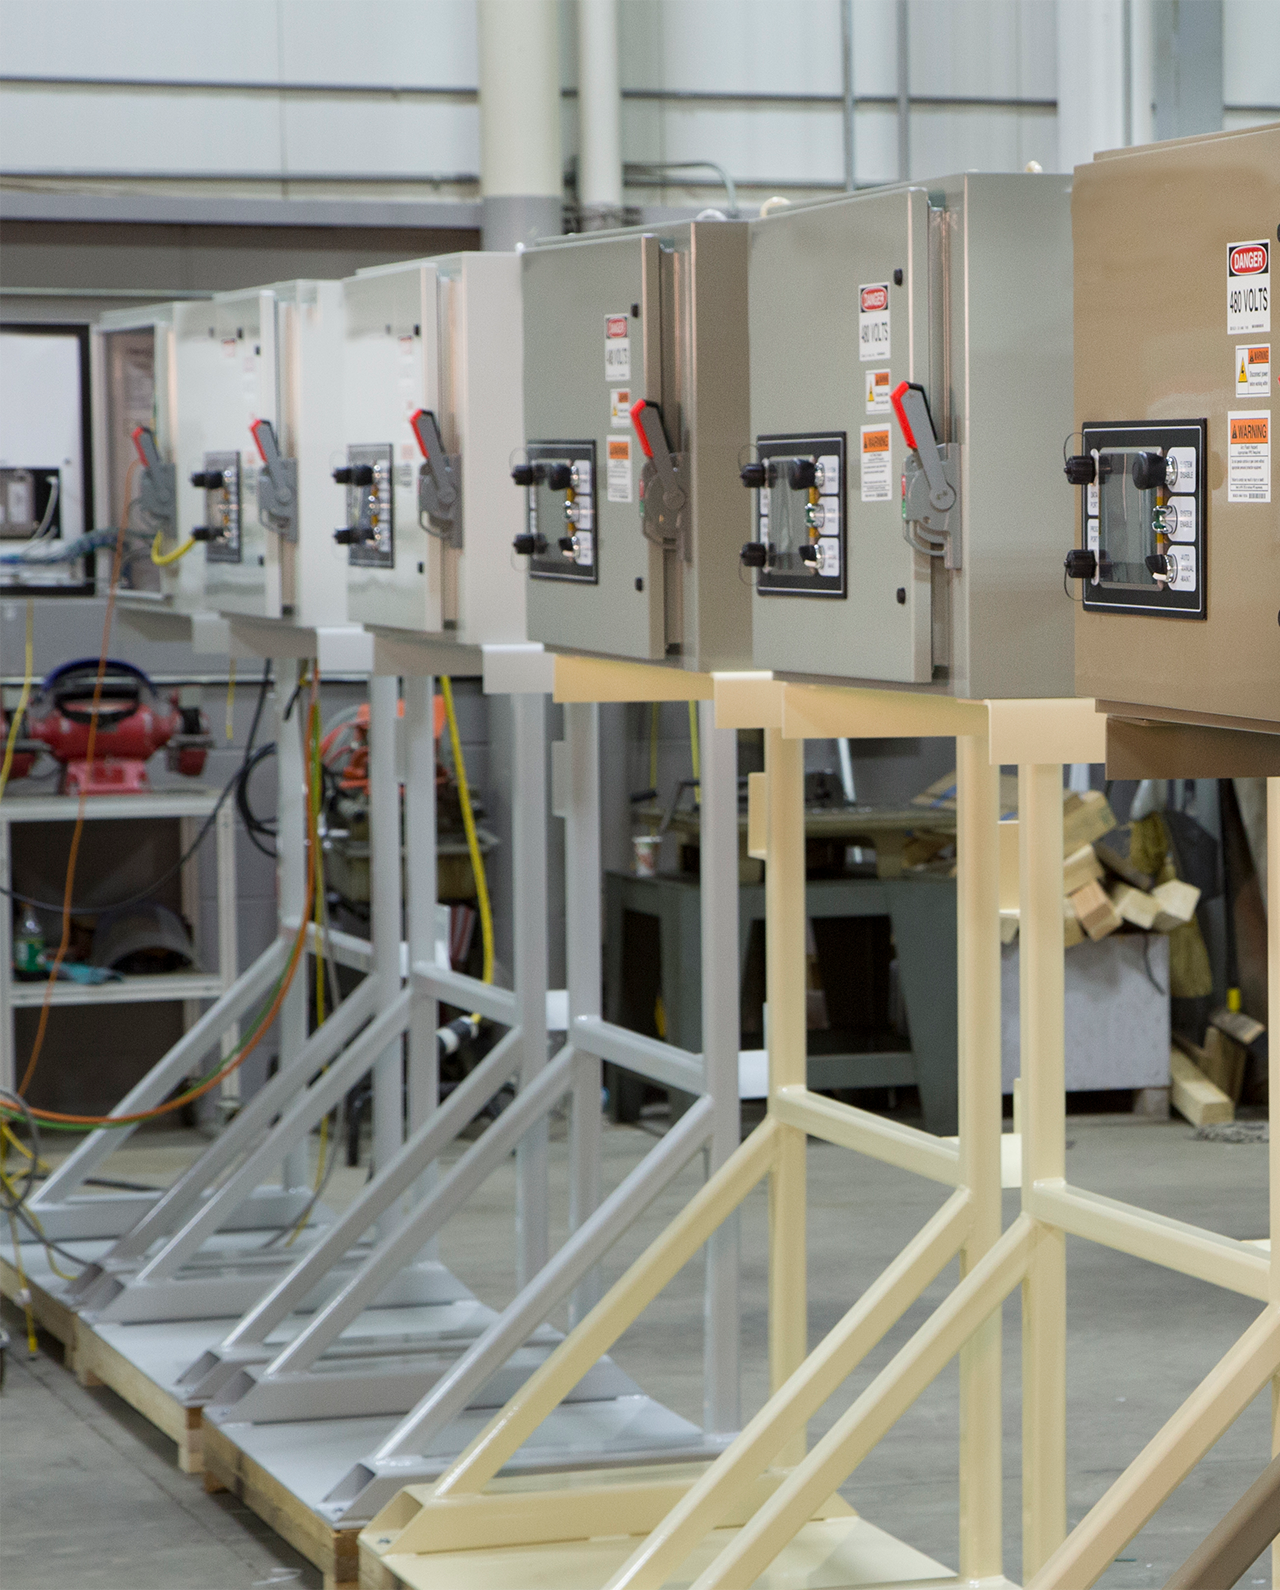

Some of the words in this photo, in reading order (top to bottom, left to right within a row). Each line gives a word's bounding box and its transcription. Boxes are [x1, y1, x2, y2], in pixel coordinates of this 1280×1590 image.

[1234, 251, 1263, 269] DANGER
[1230, 290, 1241, 313] 480
[1243, 287, 1268, 312] VOLTS
[1238, 424, 1266, 438] WARNING
